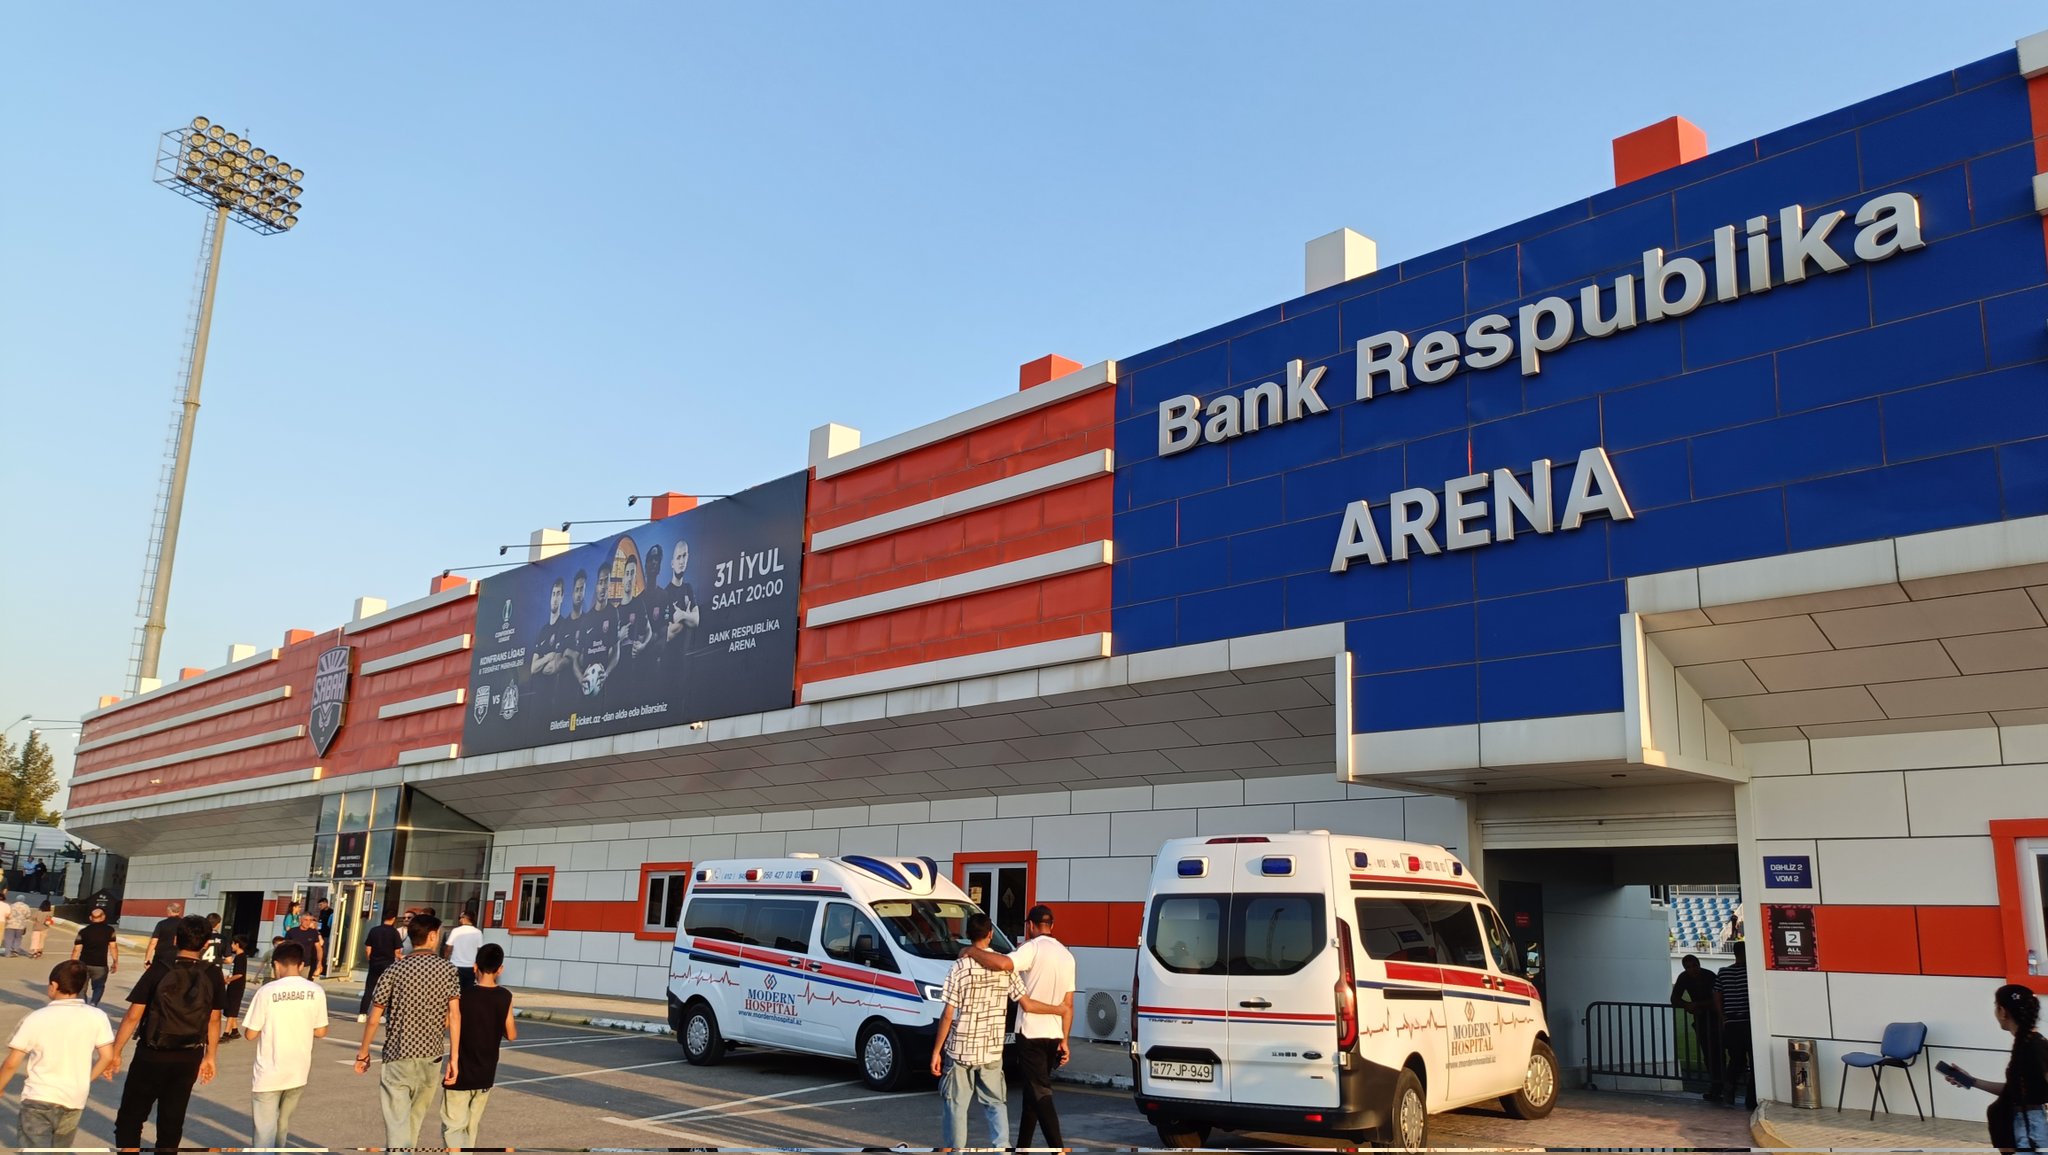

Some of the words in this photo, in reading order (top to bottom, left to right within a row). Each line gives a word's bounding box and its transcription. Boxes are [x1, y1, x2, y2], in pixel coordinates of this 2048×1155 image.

[1158, 358, 1329, 457] Bank
[1355, 191, 1927, 401] Respublika
[1329, 447, 1635, 573] ARENA
[714, 560, 733, 588] 31
[739, 547, 785, 581] İYUL
[711, 588, 744, 611] SAAT
[746, 578, 784, 603] 20:00
[708, 630, 731, 645] BANK
[731, 619, 780, 640] RESPUBLİKA
[728, 637, 757, 653] ARENA
[313, 671, 345, 706] SABAH
[492, 694, 501, 705] VS
[1770, 862, 1797, 871] DƏHLİZ
[1787, 933, 1798, 944] 2
[202, 945, 216, 963] 4
[306, 991, 315, 1001] FK
[747, 988, 796, 1005] MODERN
[744, 998, 798, 1017] HOSPITAL
[1453, 1021, 1491, 1040] MODERN
[1451, 1036, 1494, 1057] HOSPITAL
